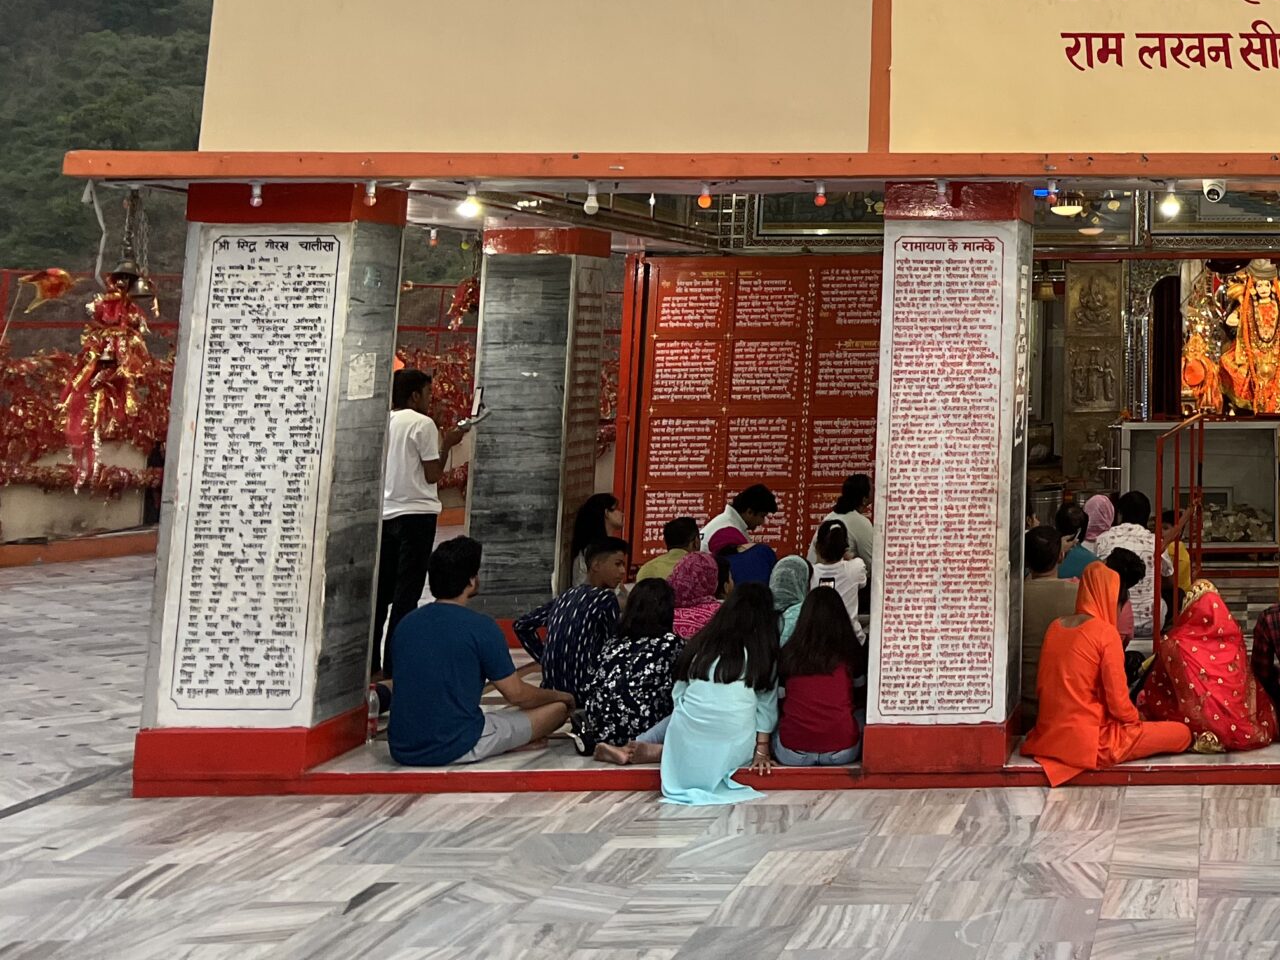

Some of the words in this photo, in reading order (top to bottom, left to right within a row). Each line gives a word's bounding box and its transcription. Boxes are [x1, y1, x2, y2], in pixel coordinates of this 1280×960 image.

[1061, 32, 1126, 71] राम
[298, 237, 335, 252] चालीसा
[902, 241, 946, 253] रामायण
[947, 239, 958, 253] के
